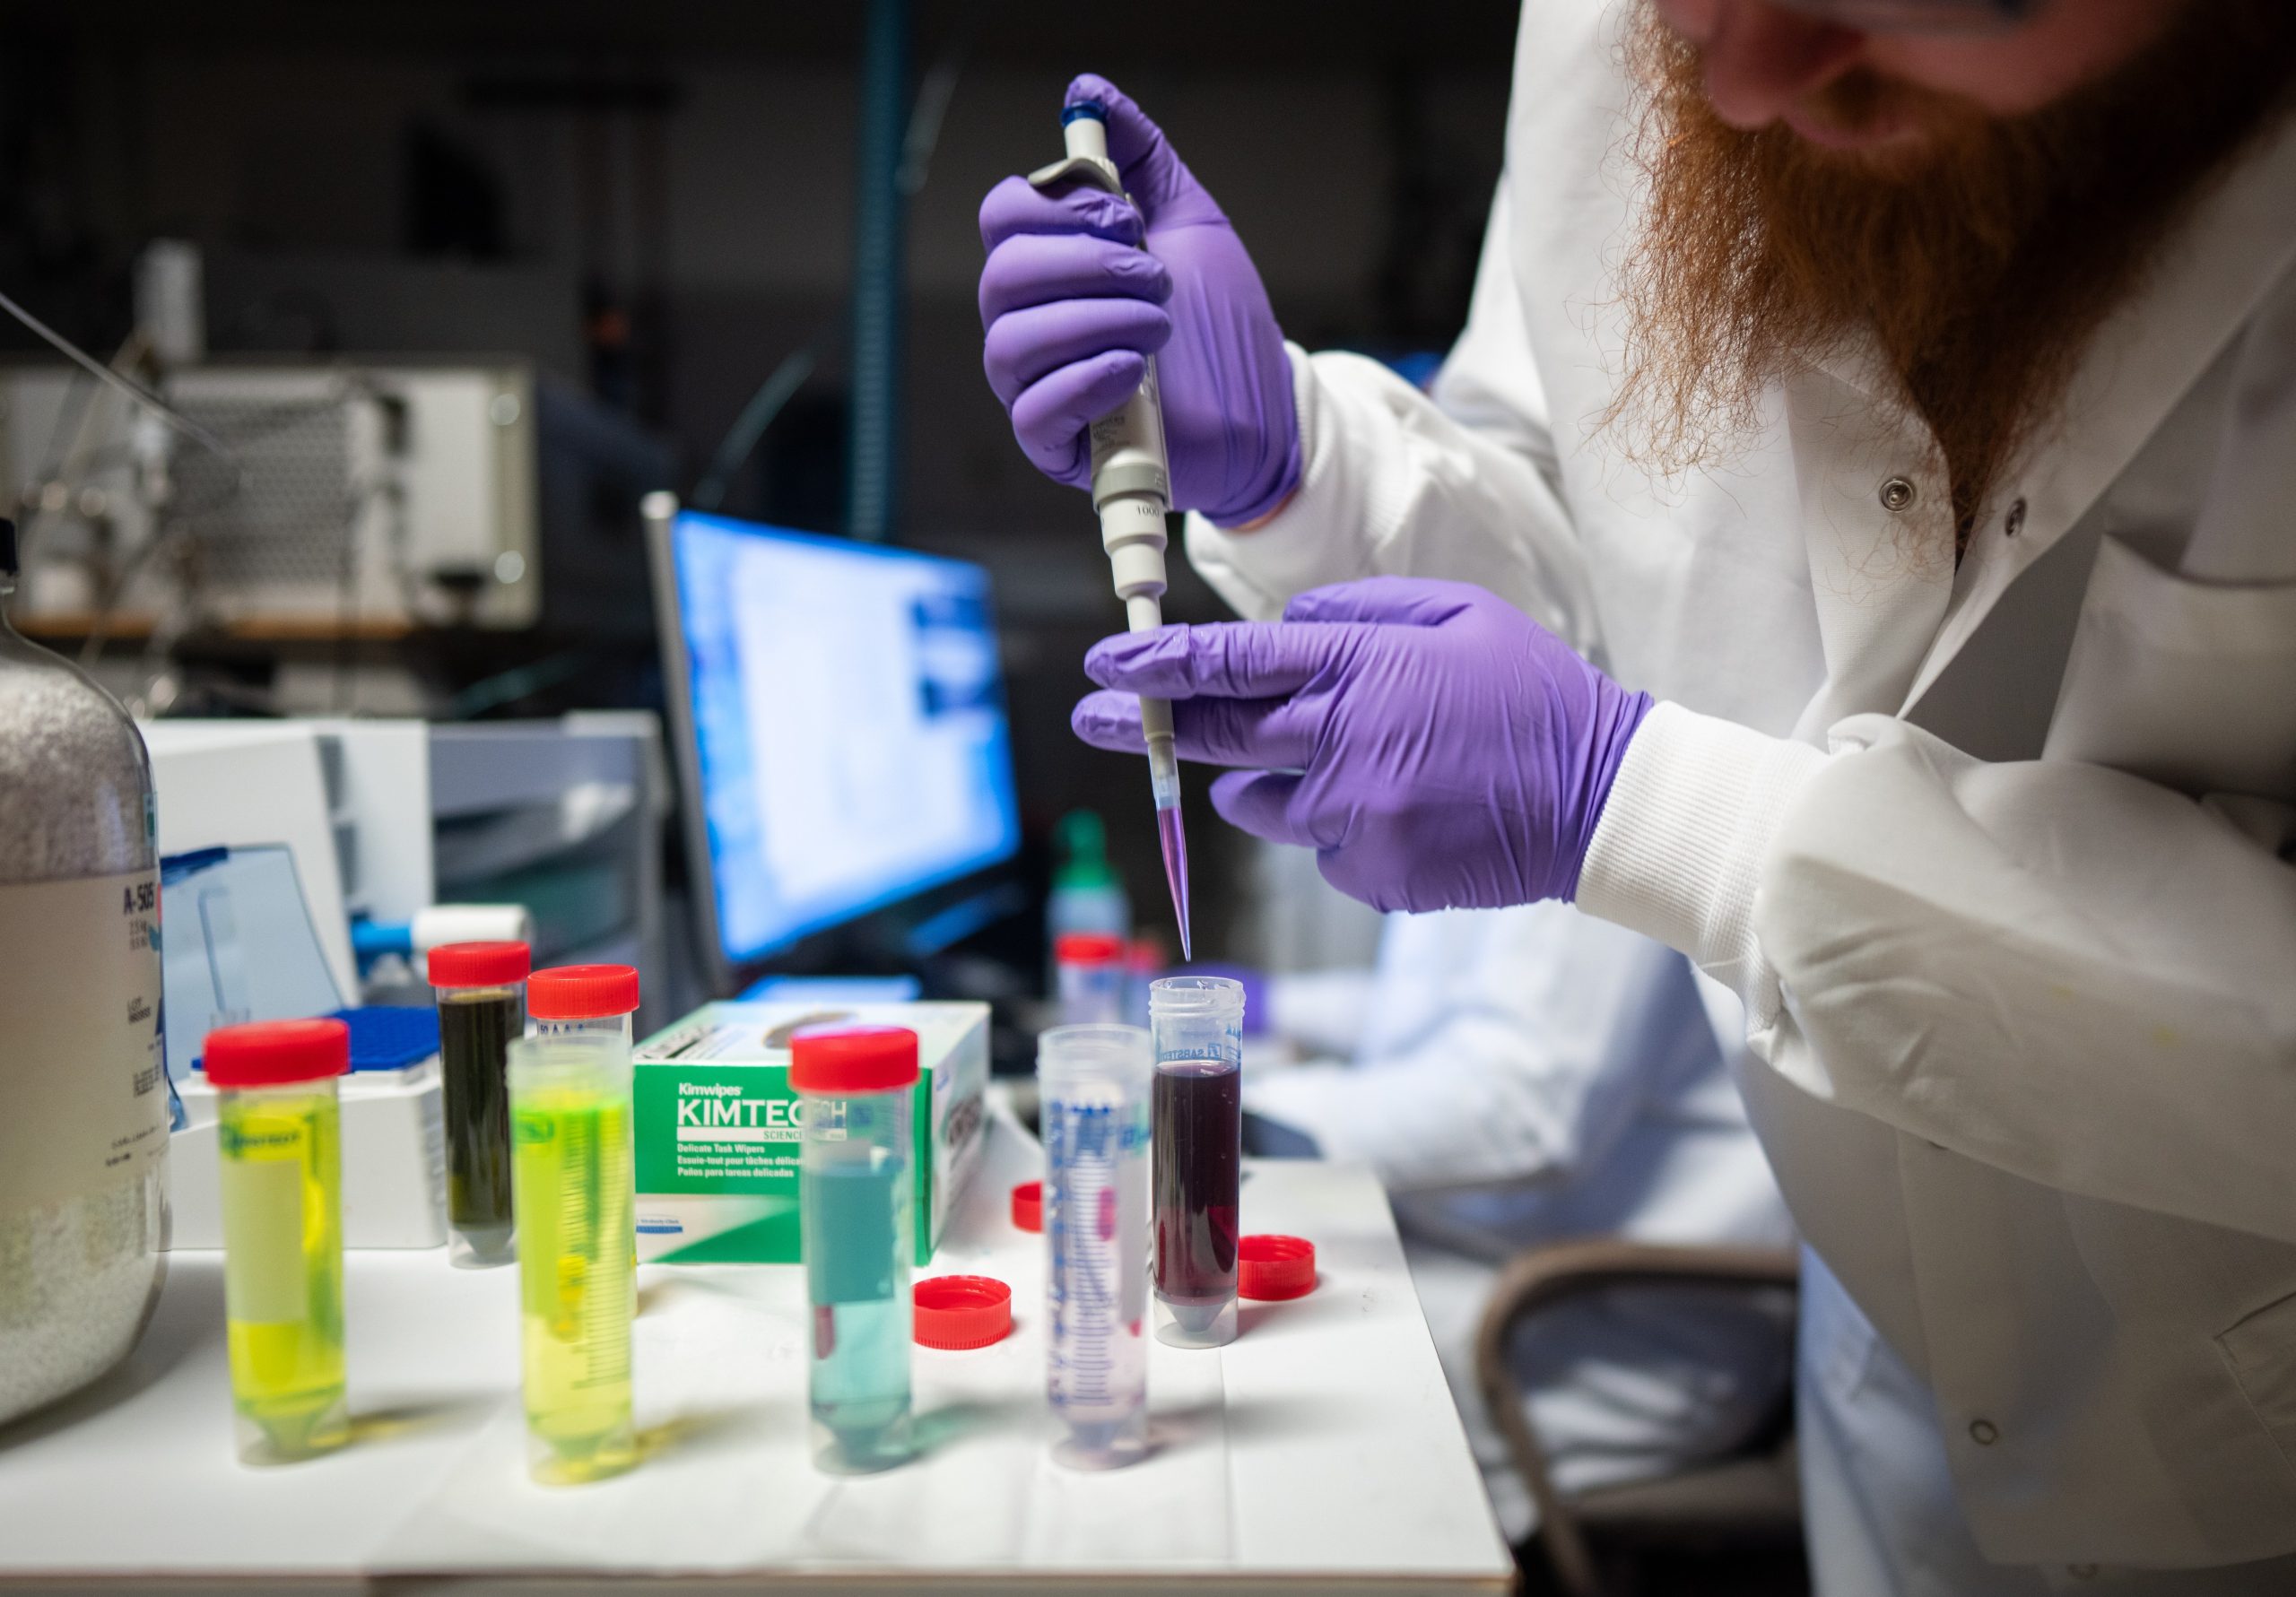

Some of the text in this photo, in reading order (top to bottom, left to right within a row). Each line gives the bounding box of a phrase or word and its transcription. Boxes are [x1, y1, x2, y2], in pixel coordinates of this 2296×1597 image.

[1137, 505, 1160, 517] 1000
[679, 1082, 742, 1098] Kimwipes
[677, 1143, 765, 1155] Delicate Task Wipers
[677, 1155, 723, 1165] Essuie-tout
[726, 1157, 744, 1167] pour
[677, 1167, 794, 1178] Paños para tareas delicadas
